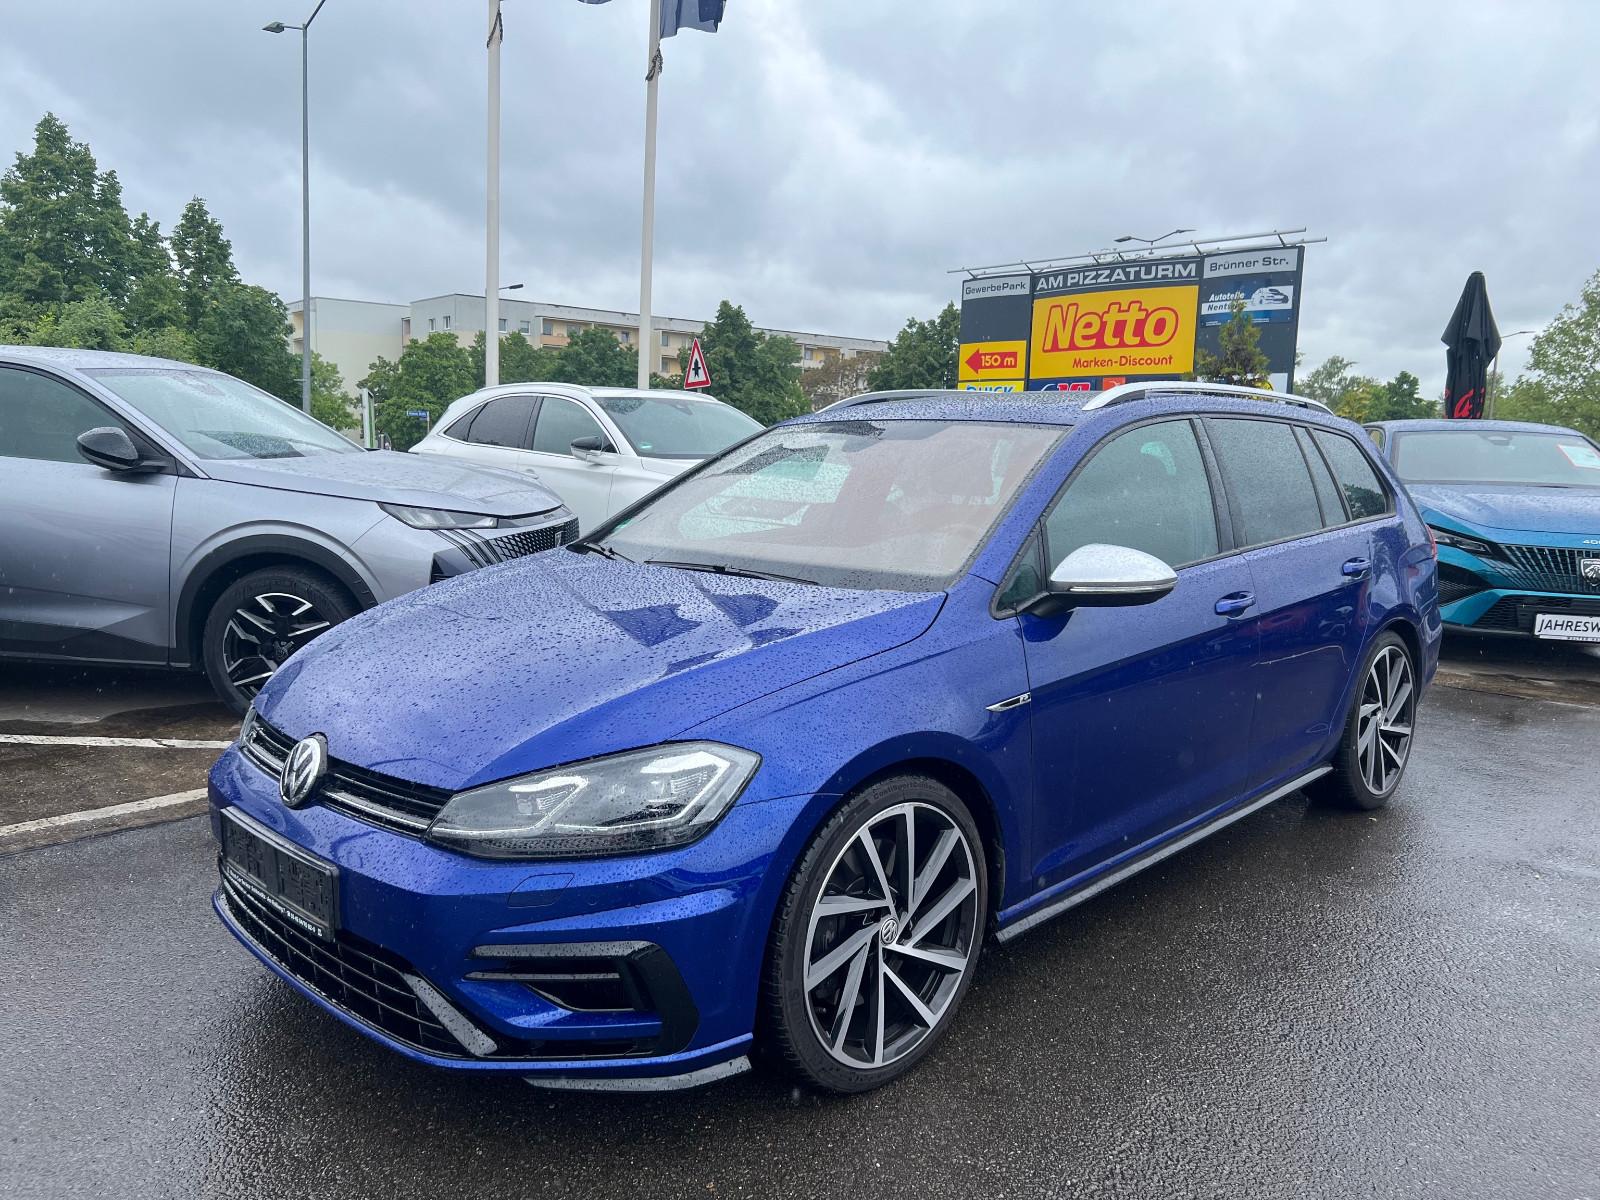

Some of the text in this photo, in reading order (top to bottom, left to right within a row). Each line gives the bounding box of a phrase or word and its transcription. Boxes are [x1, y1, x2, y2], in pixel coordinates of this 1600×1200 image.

[1209, 256, 1289, 272] Brünner Str.
[1036, 263, 1197, 291] AM PIZZATURM
[965, 281, 1026, 295] GewerbePark
[1043, 300, 1179, 353] Netto
[981, 354, 1015, 367] 150 m
[1072, 354, 1173, 369] Marken-Discount
